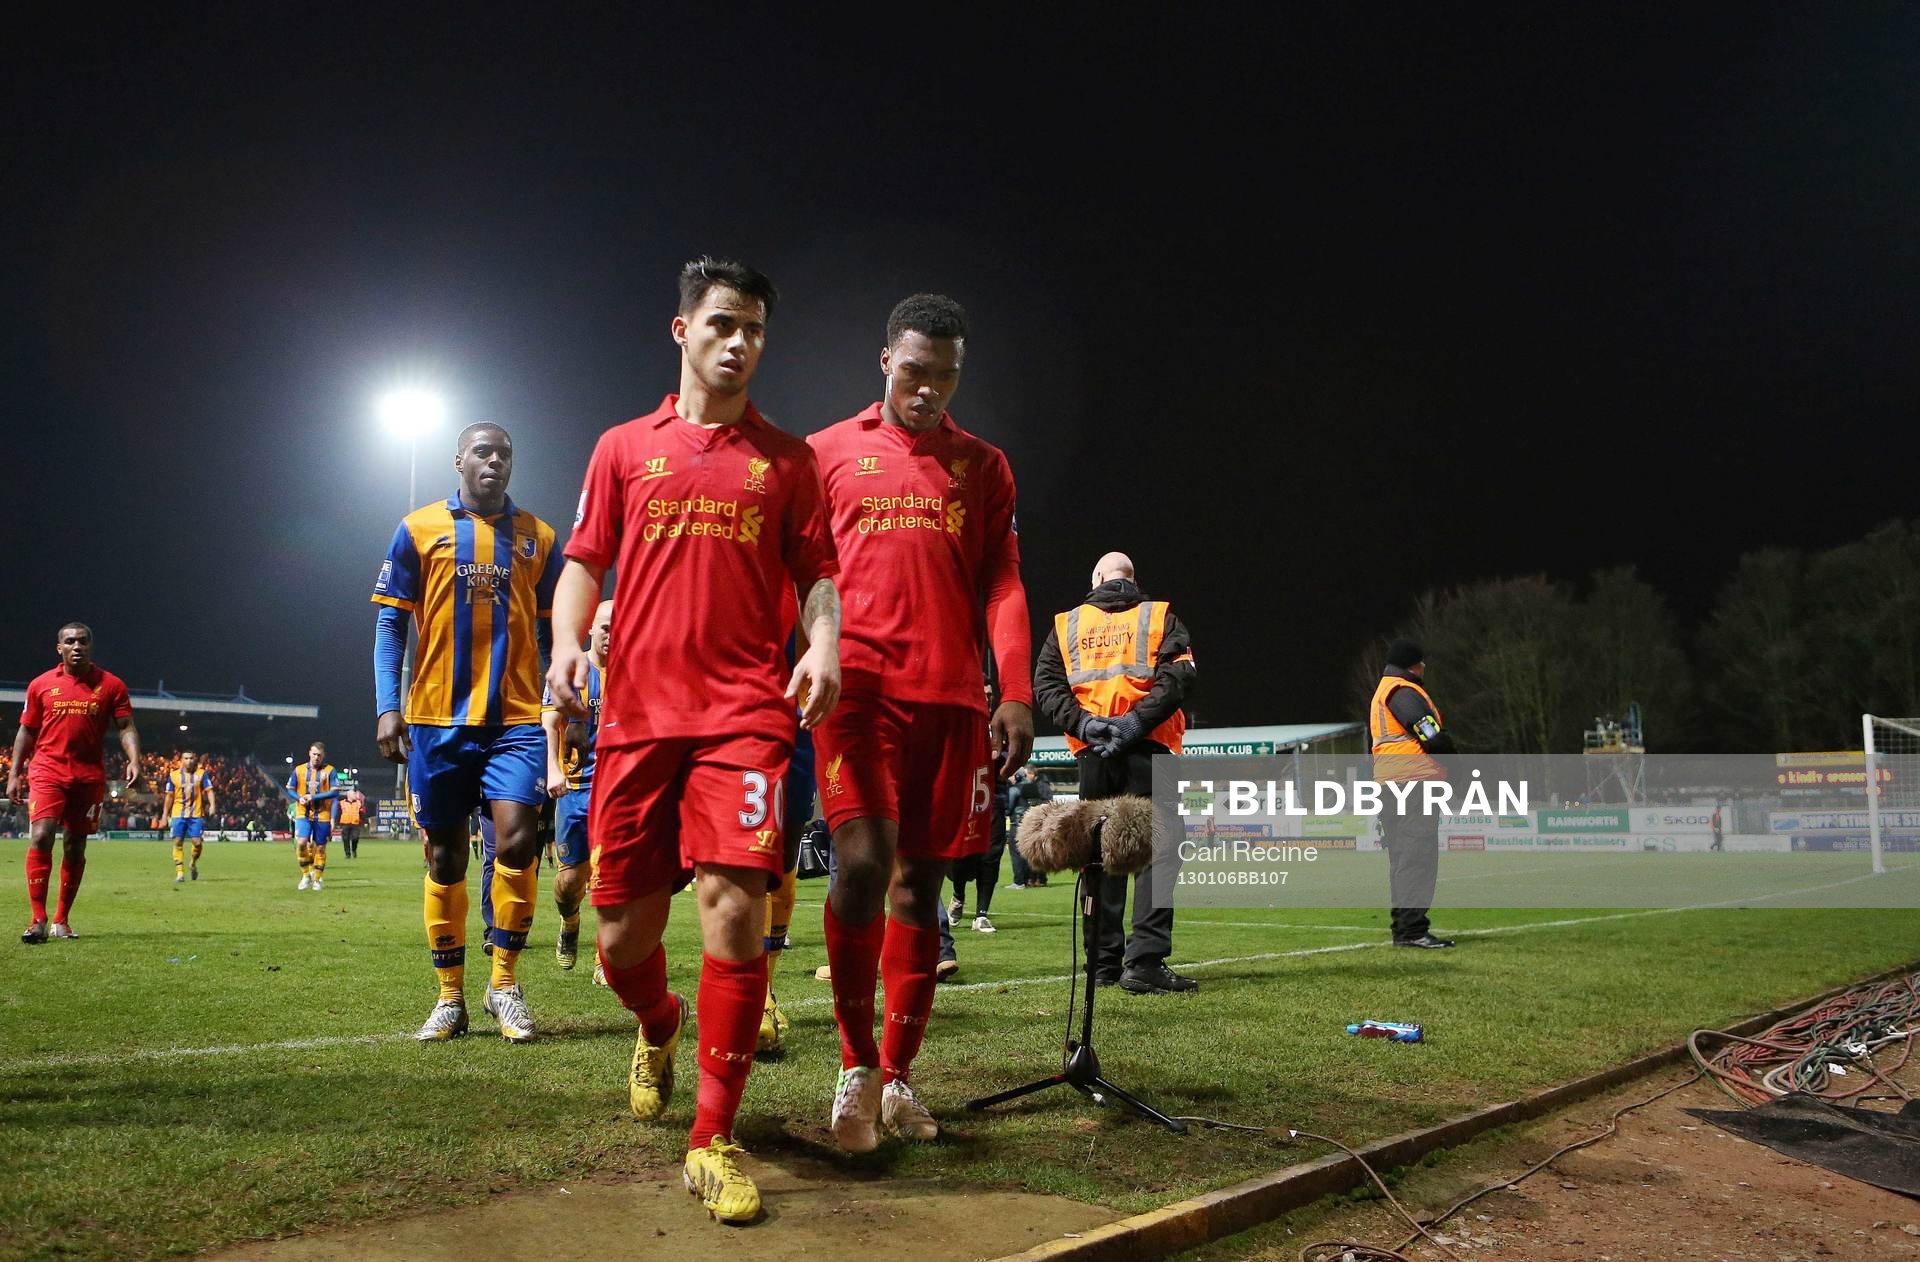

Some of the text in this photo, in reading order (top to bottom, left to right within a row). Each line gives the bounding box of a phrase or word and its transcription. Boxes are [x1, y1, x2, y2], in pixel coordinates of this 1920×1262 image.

[647, 494, 737, 518] Standard
[861, 492, 942, 513] Standard
[643, 520, 733, 542] Chartered
[857, 513, 942, 534] Chartered
[456, 563, 510, 580] GREENE
[467, 576, 500, 587] KING
[1081, 631, 1134, 650] SECURITY
[1182, 744, 1253, 756] OOTBALL CLUB
[1548, 816, 1618, 827] RAINWORTH
[1488, 836, 1533, 846] Mansfield
